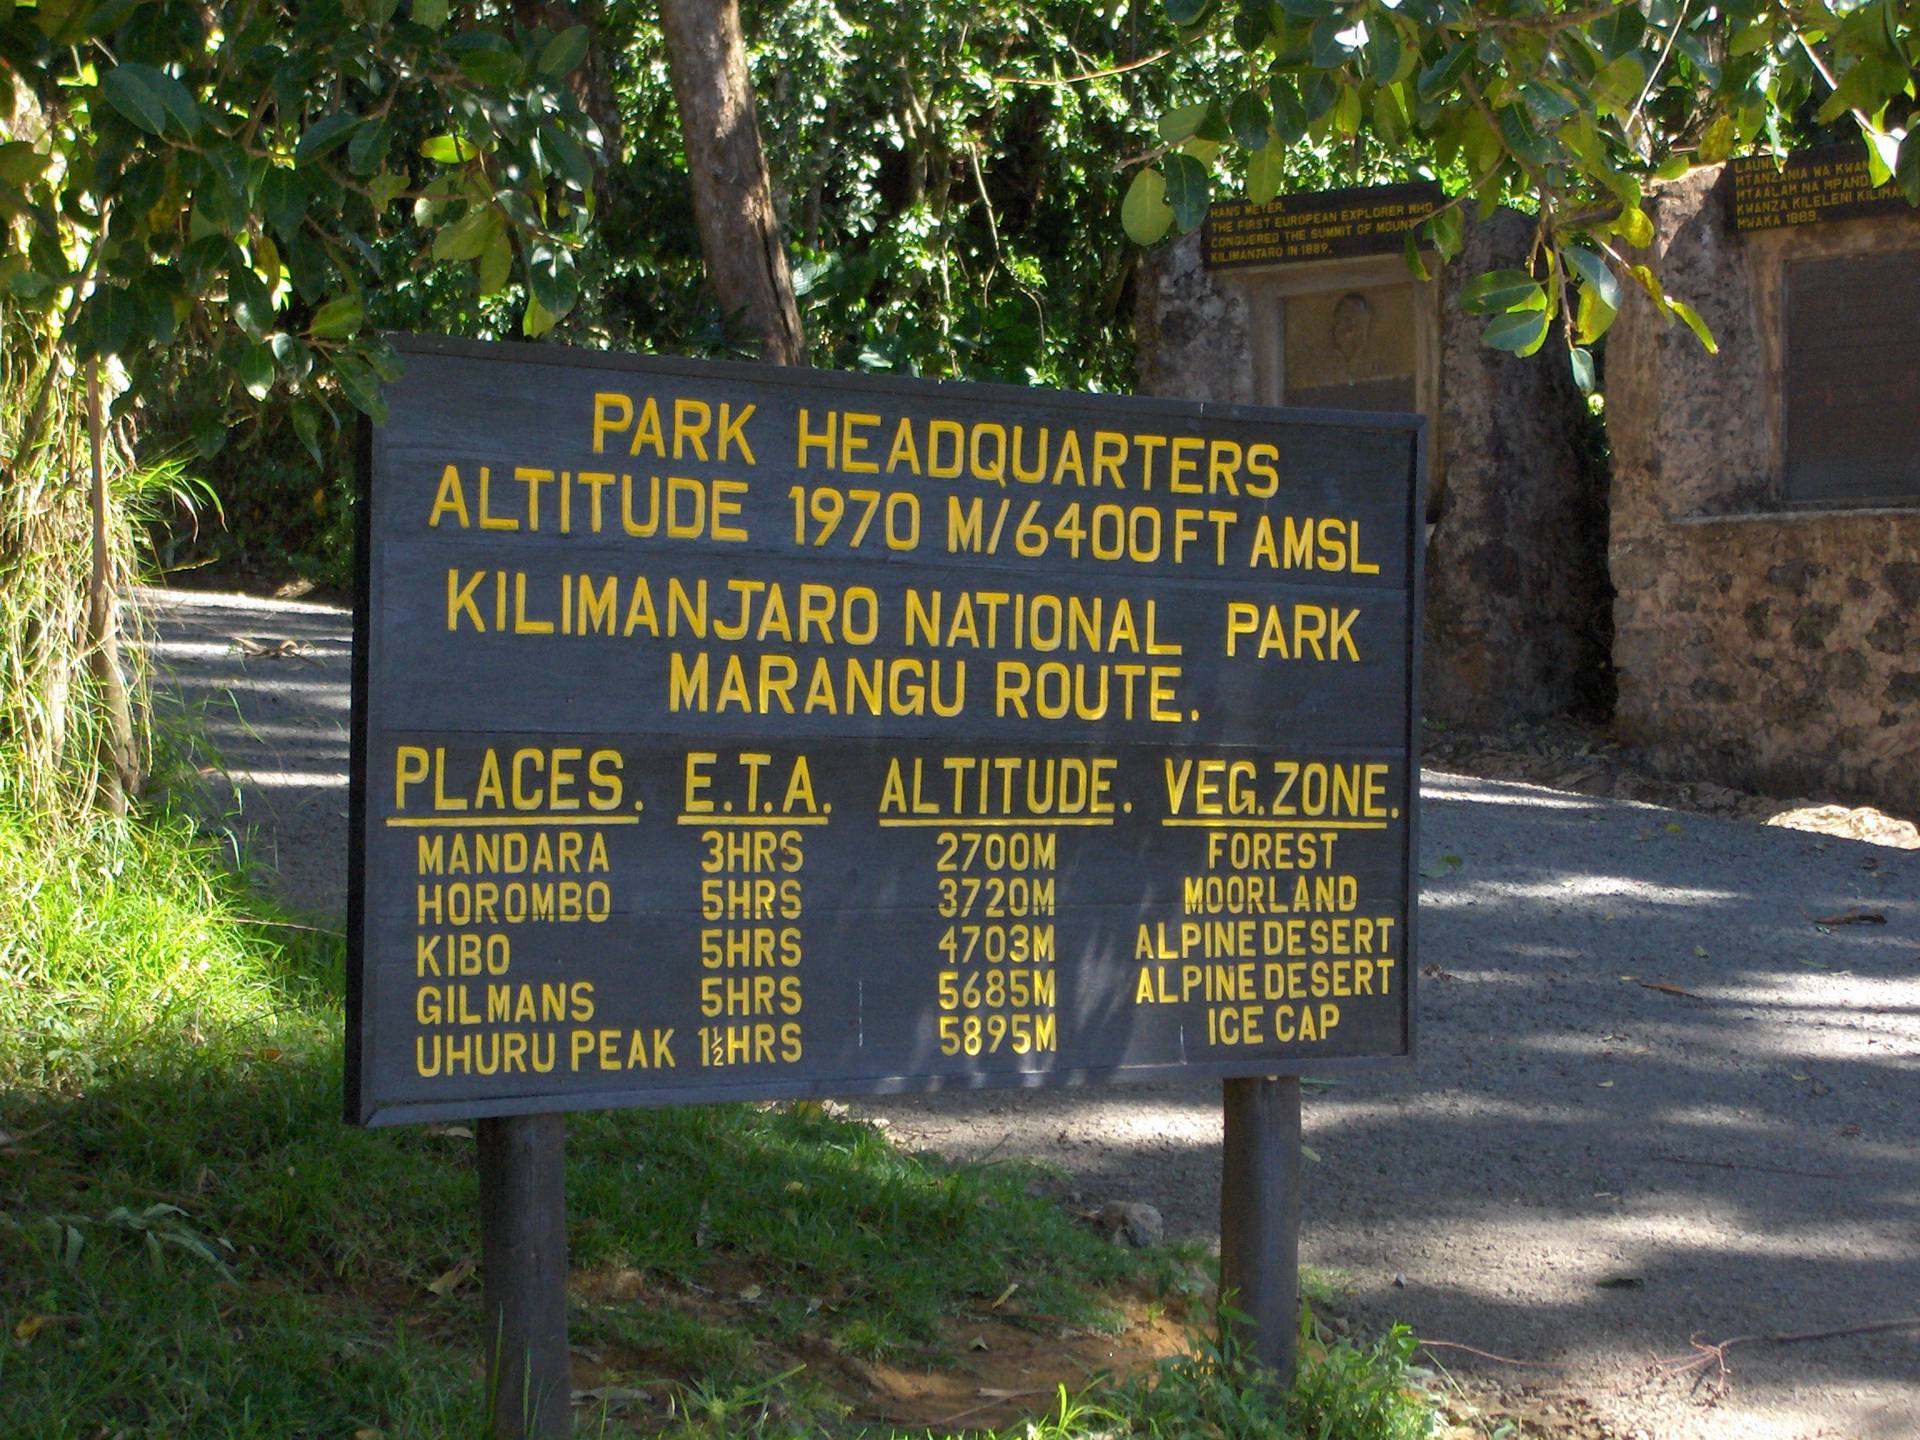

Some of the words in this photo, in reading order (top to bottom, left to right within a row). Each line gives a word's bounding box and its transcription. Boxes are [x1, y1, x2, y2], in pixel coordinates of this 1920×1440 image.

[1801, 181, 1820, 194] NA
[1824, 174, 1871, 191] MPAND
[1813, 165, 1831, 177] WA
[1212, 221, 1234, 234] THE
[1238, 218, 1270, 231] FIRST
[1274, 211, 1337, 229] EUROPEAN
[1341, 205, 1405, 222] EXPLORER
[1408, 202, 1434, 215] WHO
[1737, 200, 1789, 216] KWANZA
[1793, 191, 1853, 209] KILELENI
[1737, 213, 1780, 230] MWAKA
[1211, 232, 1279, 249] CONQUERED
[1284, 229, 1306, 242] THE
[1311, 224, 1353, 240] SUMMIT
[1357, 223, 1372, 236] OF
[1287, 245, 1298, 257] IN
[593, 392, 756, 464] PARK
[798, 408, 1280, 499] HEADQUARTERS
[428, 464, 749, 541] ALTITUDE
[789, 485, 920, 550] 1970
[1173, 507, 1237, 564] FT
[1249, 514, 1380, 574] AMSL
[447, 568, 878, 644] KILIMANJARO
[904, 588, 1182, 656] NATIONAL
[1226, 601, 1360, 661] PARK
[669, 651, 966, 716] MARANGU
[995, 660, 1200, 723] ROUTE.
[395, 745, 642, 810] PLACES.
[684, 751, 832, 813] E.T.A.
[880, 756, 1132, 814] ALTITUDE.
[418, 831, 609, 874] MANDARA
[702, 829, 803, 872] 3HRS
[936, 831, 1056, 871] 2700M
[1208, 831, 1337, 869] FOREST
[417, 880, 609, 925] HOROMBO
[701, 878, 800, 920] 5HRS
[939, 876, 1054, 917] 3720M
[1183, 874, 1358, 913] MOORLAND
[416, 933, 510, 976] KIBO
[700, 927, 801, 968] 5HRS
[939, 923, 1055, 963] 4703M
[1136, 920, 1256, 960] ALPINE
[1263, 916, 1394, 956] DESERT
[416, 981, 593, 1024] GILMANS
[700, 975, 801, 1016] 5HRS
[938, 968, 1056, 1010] 5685M
[1135, 962, 1259, 1006] ALPINE
[1264, 958, 1395, 1000] DESERT
[416, 1032, 555, 1076] UHURU
[570, 1028, 675, 1070] PEAK
[938, 1013, 1056, 1056] 5895M
[1207, 1005, 1264, 1045] ICE
[1275, 1002, 1340, 1041] CAP
